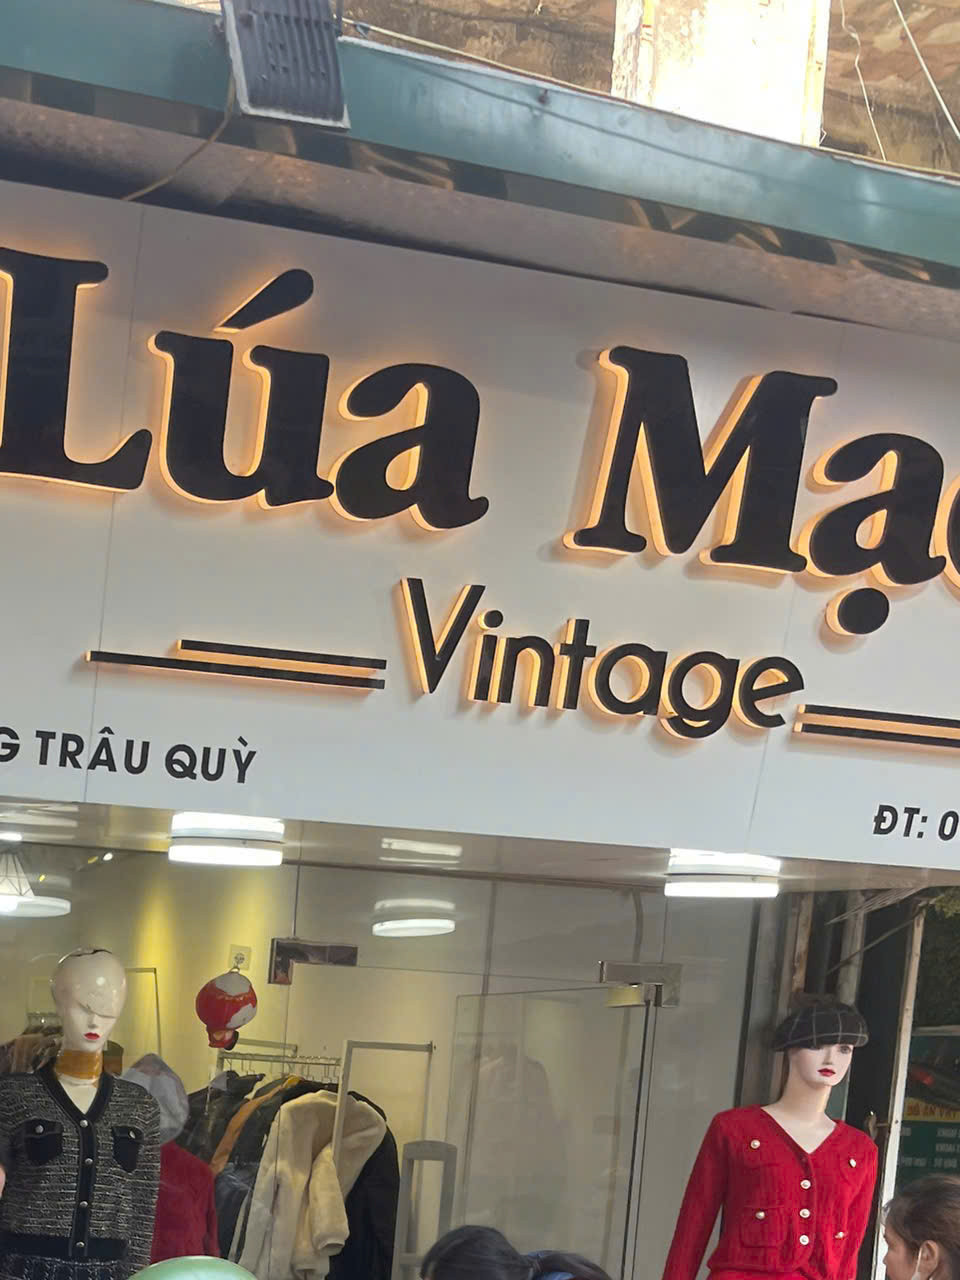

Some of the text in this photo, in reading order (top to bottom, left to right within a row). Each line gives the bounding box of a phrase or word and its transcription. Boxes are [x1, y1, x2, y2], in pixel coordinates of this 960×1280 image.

[571, 344, 960, 636] Mạ
[404, 576, 806, 740] Vintage
[36, 726, 150, 775] TRÂU
[164, 735, 257, 784] QUỲ
[872, 804, 928, 839] ĐT:
